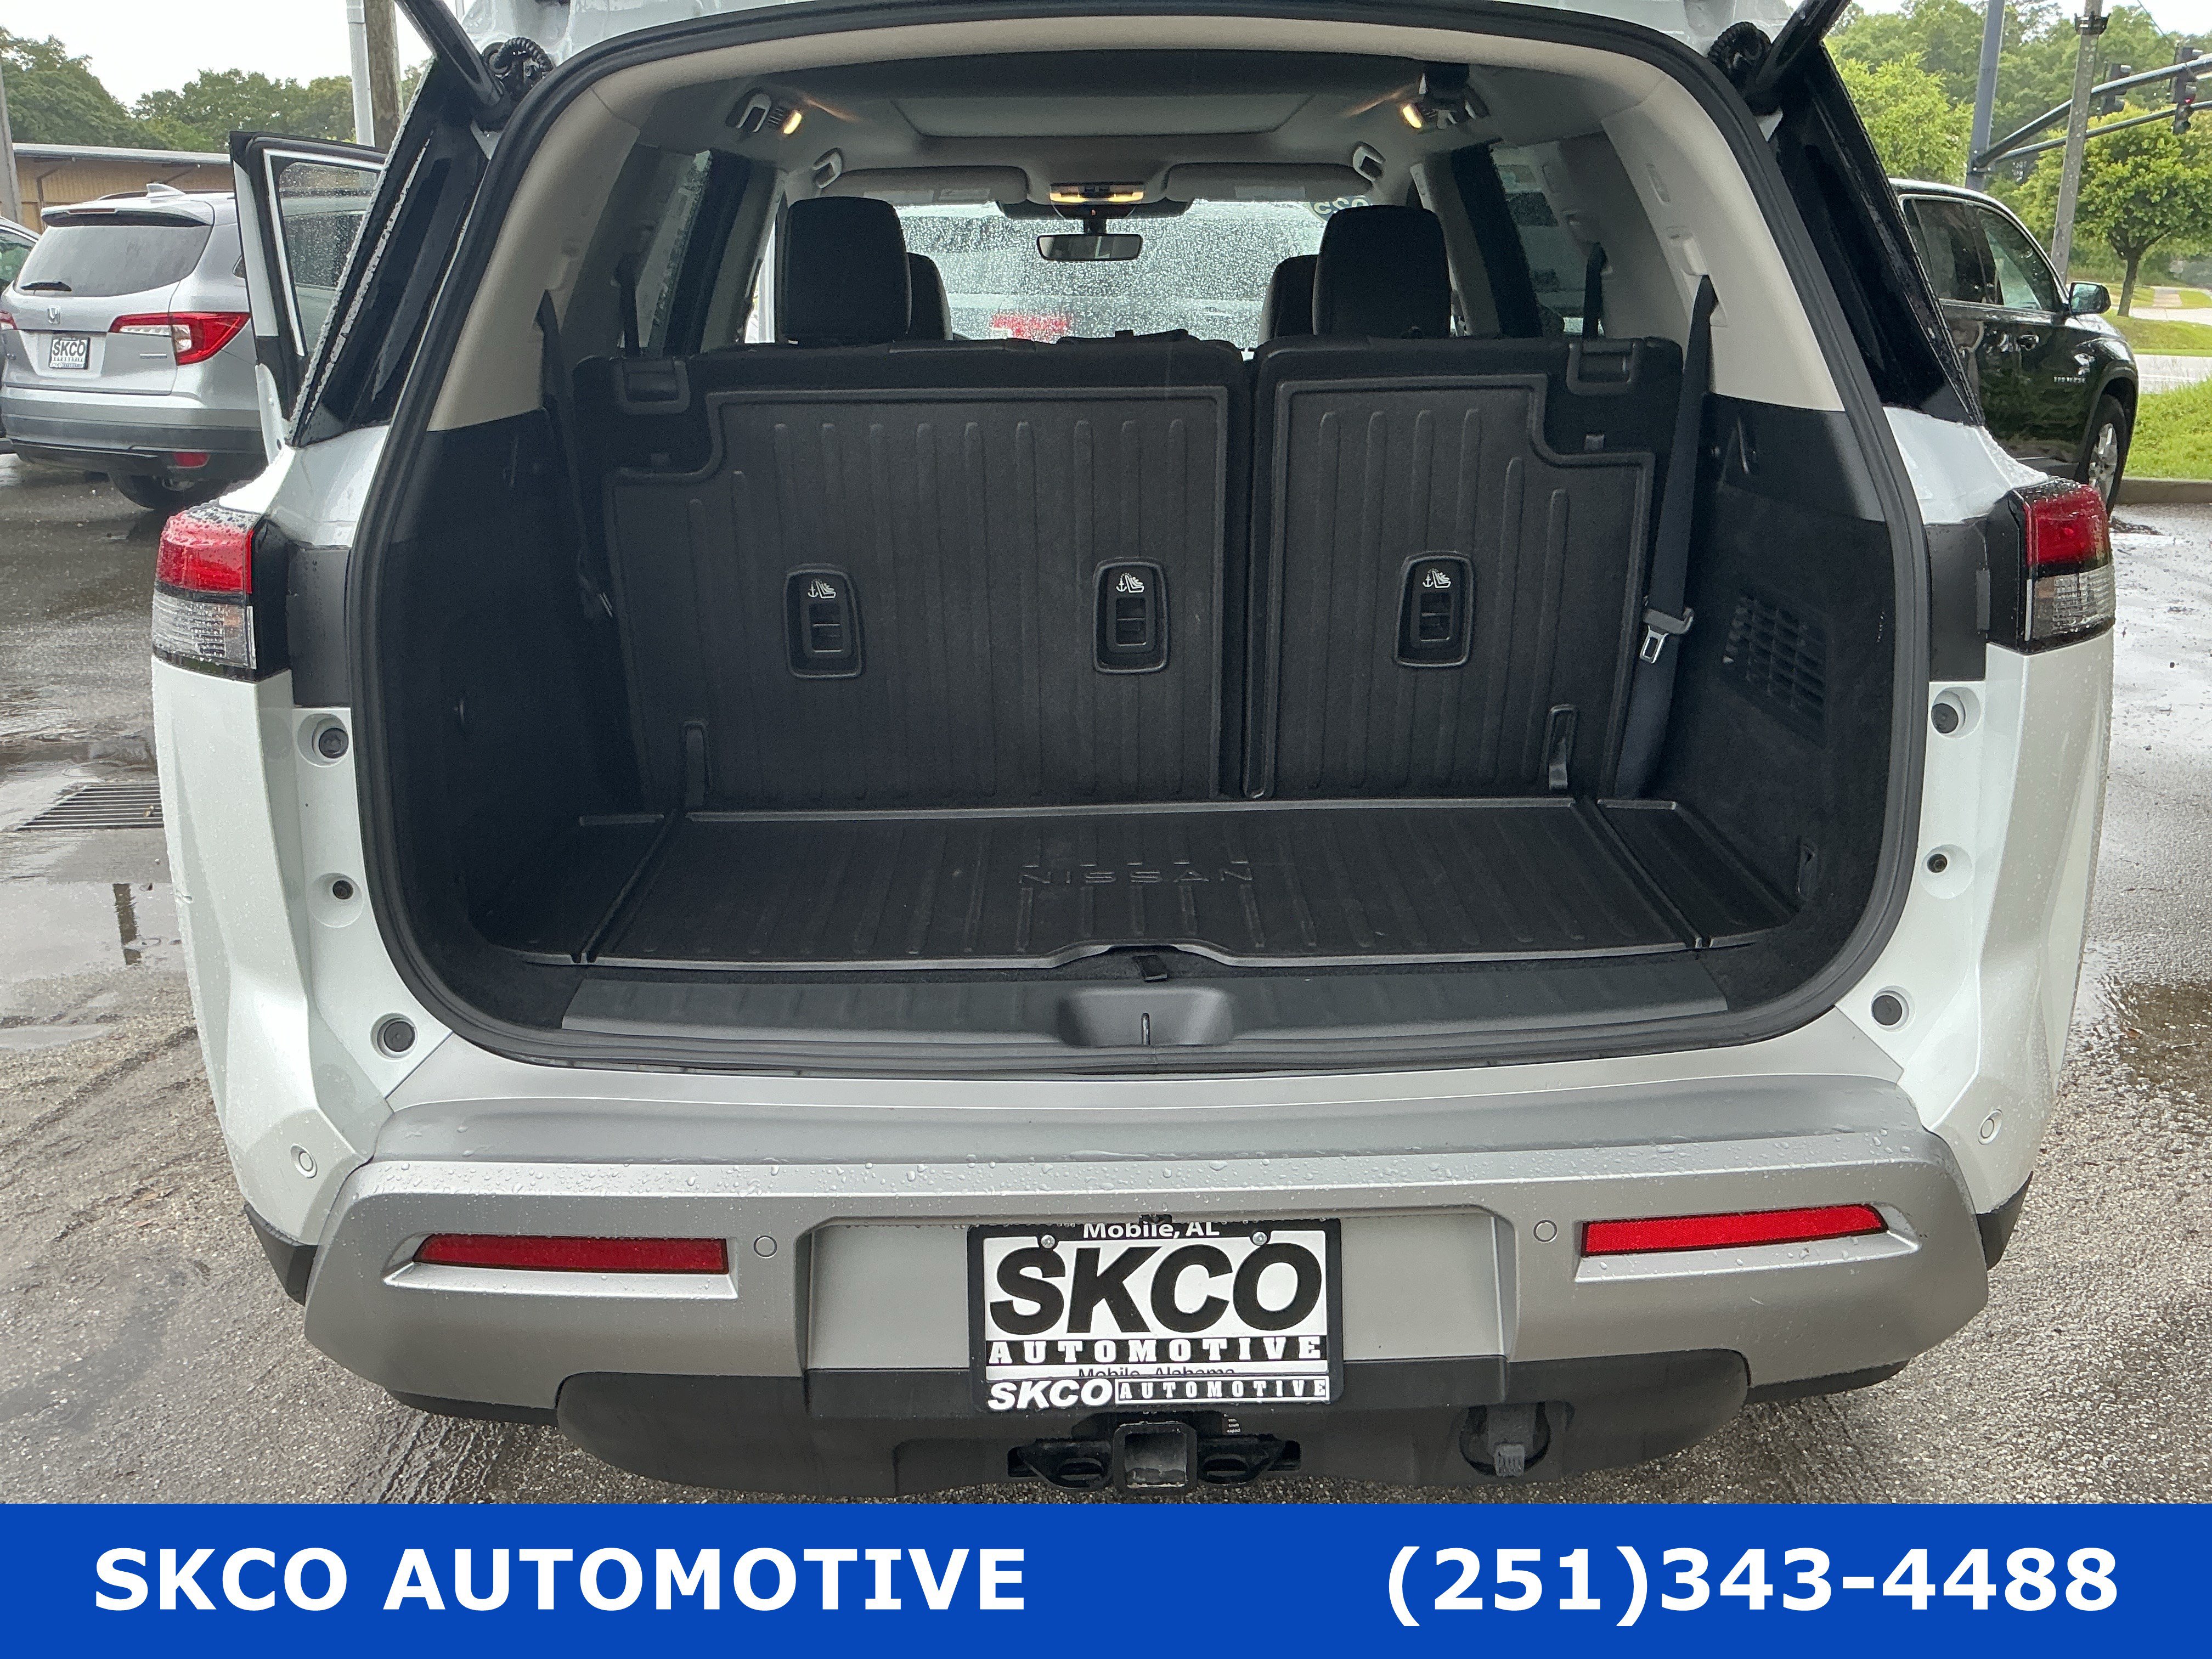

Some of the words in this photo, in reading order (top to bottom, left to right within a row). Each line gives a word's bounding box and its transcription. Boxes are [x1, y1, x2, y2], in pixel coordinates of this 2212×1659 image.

[52, 341, 86, 357] SKCO
[1019, 868, 1253, 884] NISSAN
[1083, 1221, 1181, 1239] Mobile,
[1186, 1221, 1220, 1237] AL
[990, 1242, 1322, 1335] SKCO
[988, 1335, 1322, 1364] AUTOMOTIVE
[988, 1378, 1113, 1410] SKCO
[1120, 1380, 1326, 1400] AUTOMOTIVE
